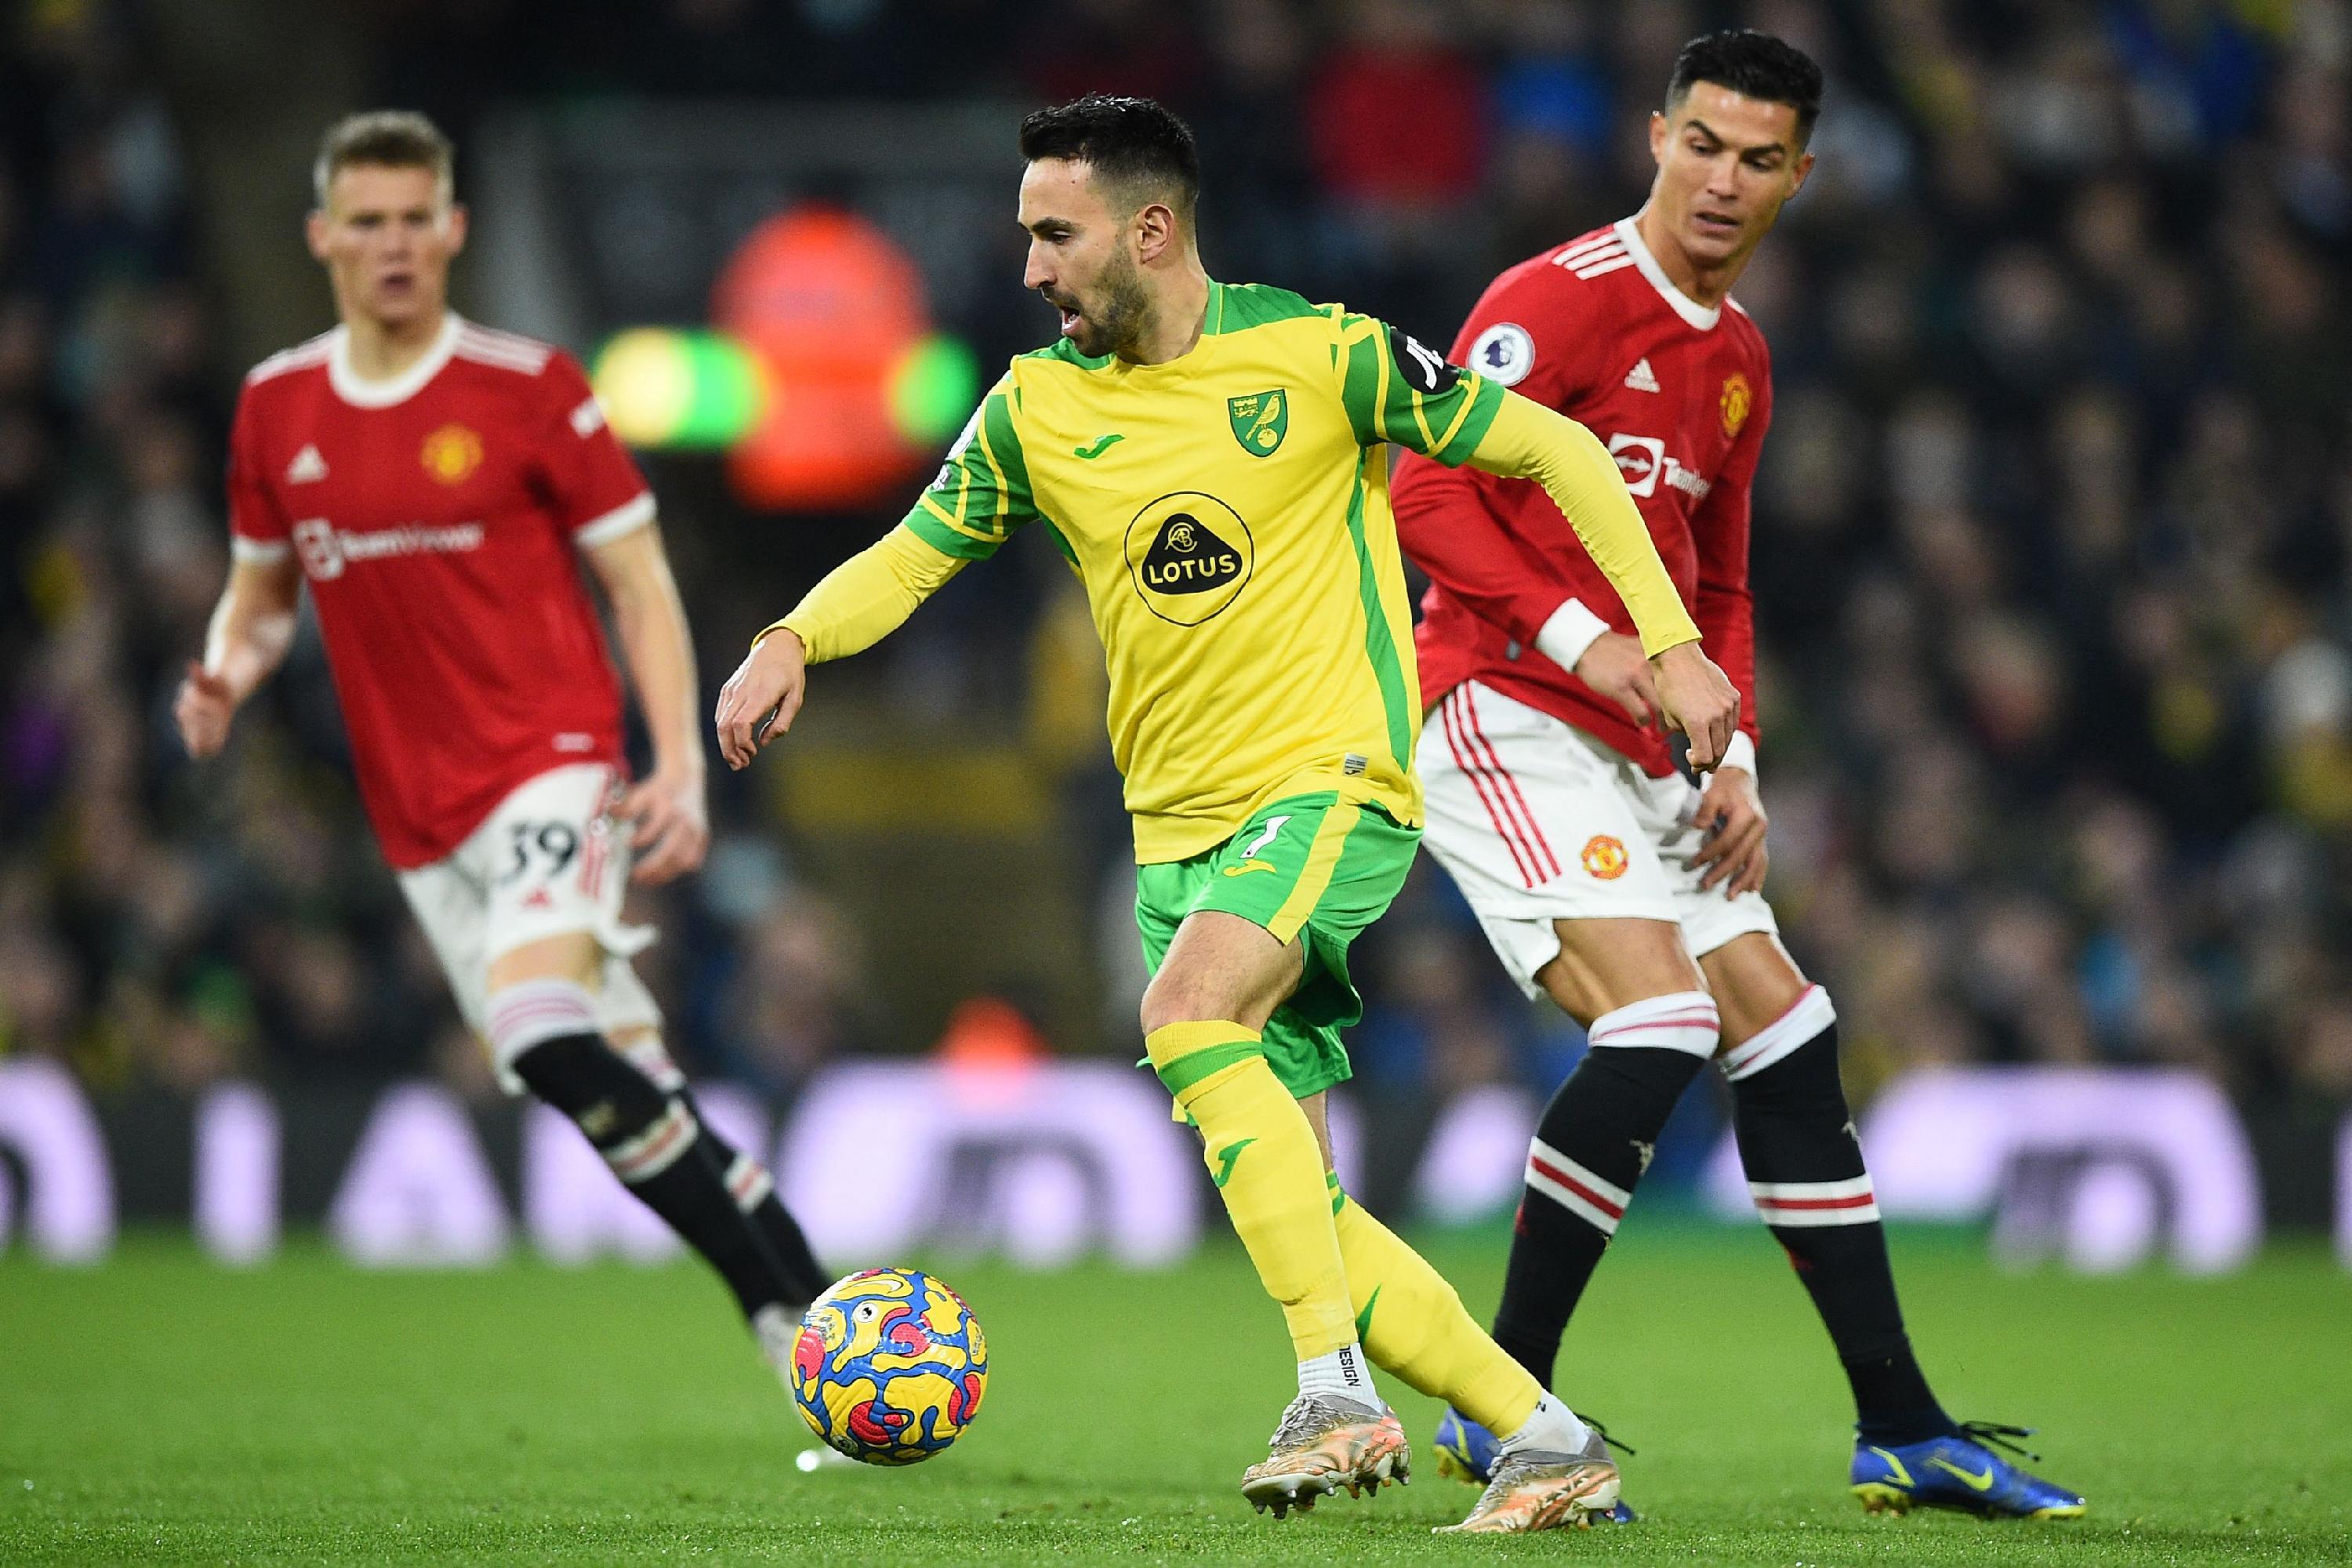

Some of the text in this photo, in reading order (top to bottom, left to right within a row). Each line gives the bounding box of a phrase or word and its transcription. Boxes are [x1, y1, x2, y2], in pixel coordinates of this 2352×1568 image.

[1149, 554, 1236, 585] LOTUS
[502, 819, 579, 885] 39
[1239, 815, 1293, 859] 7
